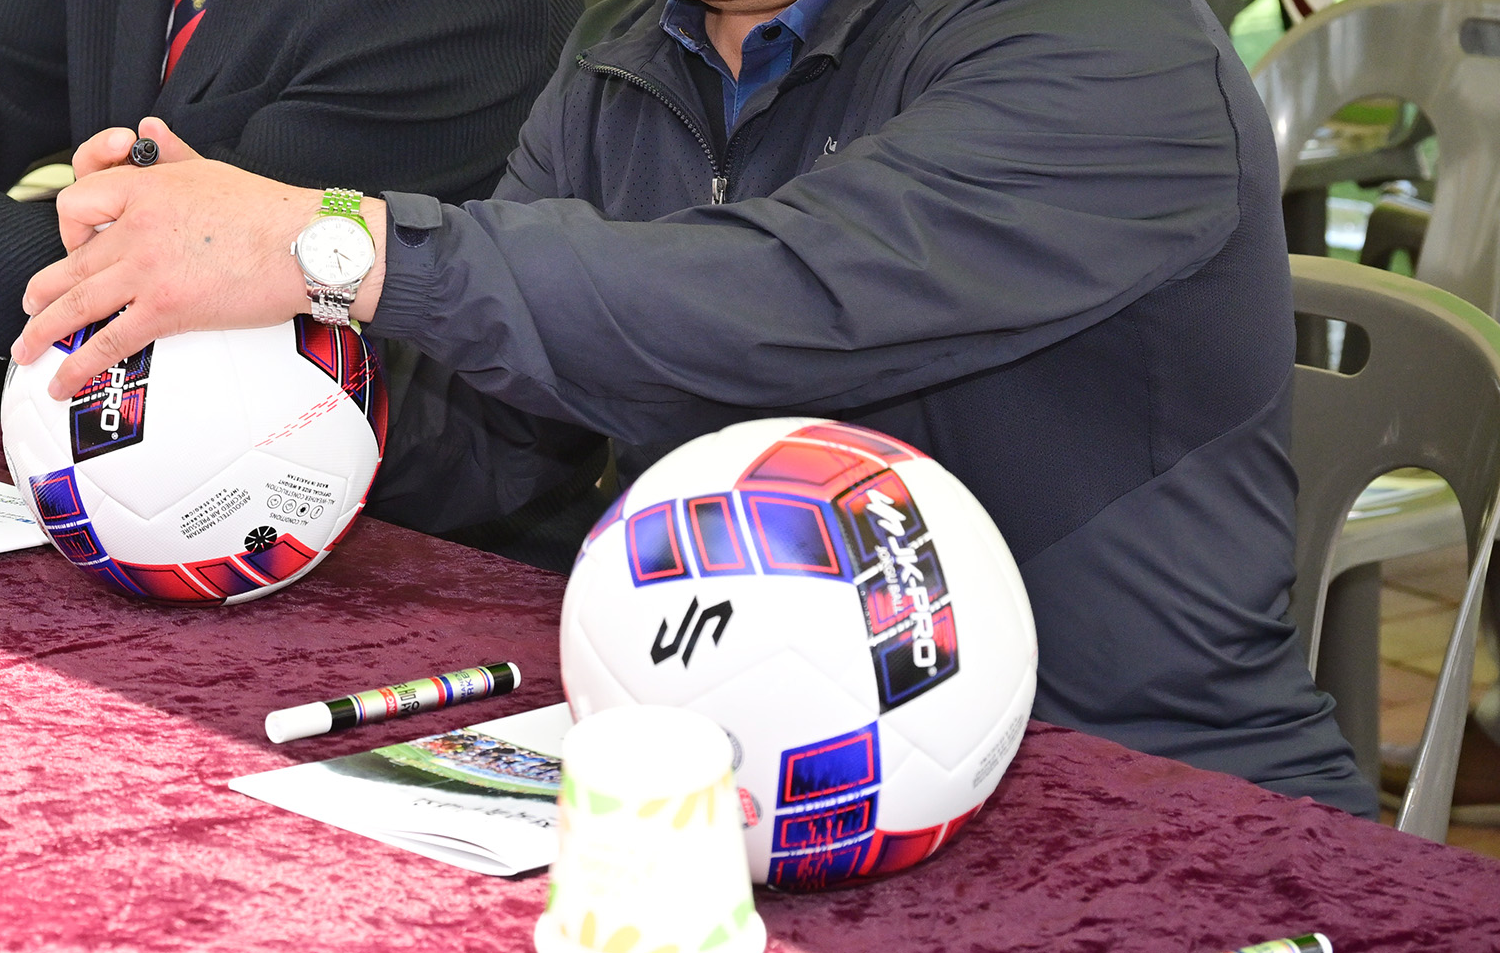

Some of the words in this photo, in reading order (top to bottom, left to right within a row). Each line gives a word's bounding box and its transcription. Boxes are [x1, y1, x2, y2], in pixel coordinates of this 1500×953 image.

[216, 495, 252, 523] ABSOLUTELY
[220, 489, 249, 512] SPECIFIED
[181, 516, 211, 536] PRESSURE
[888, 536, 937, 668] JK-PRO
